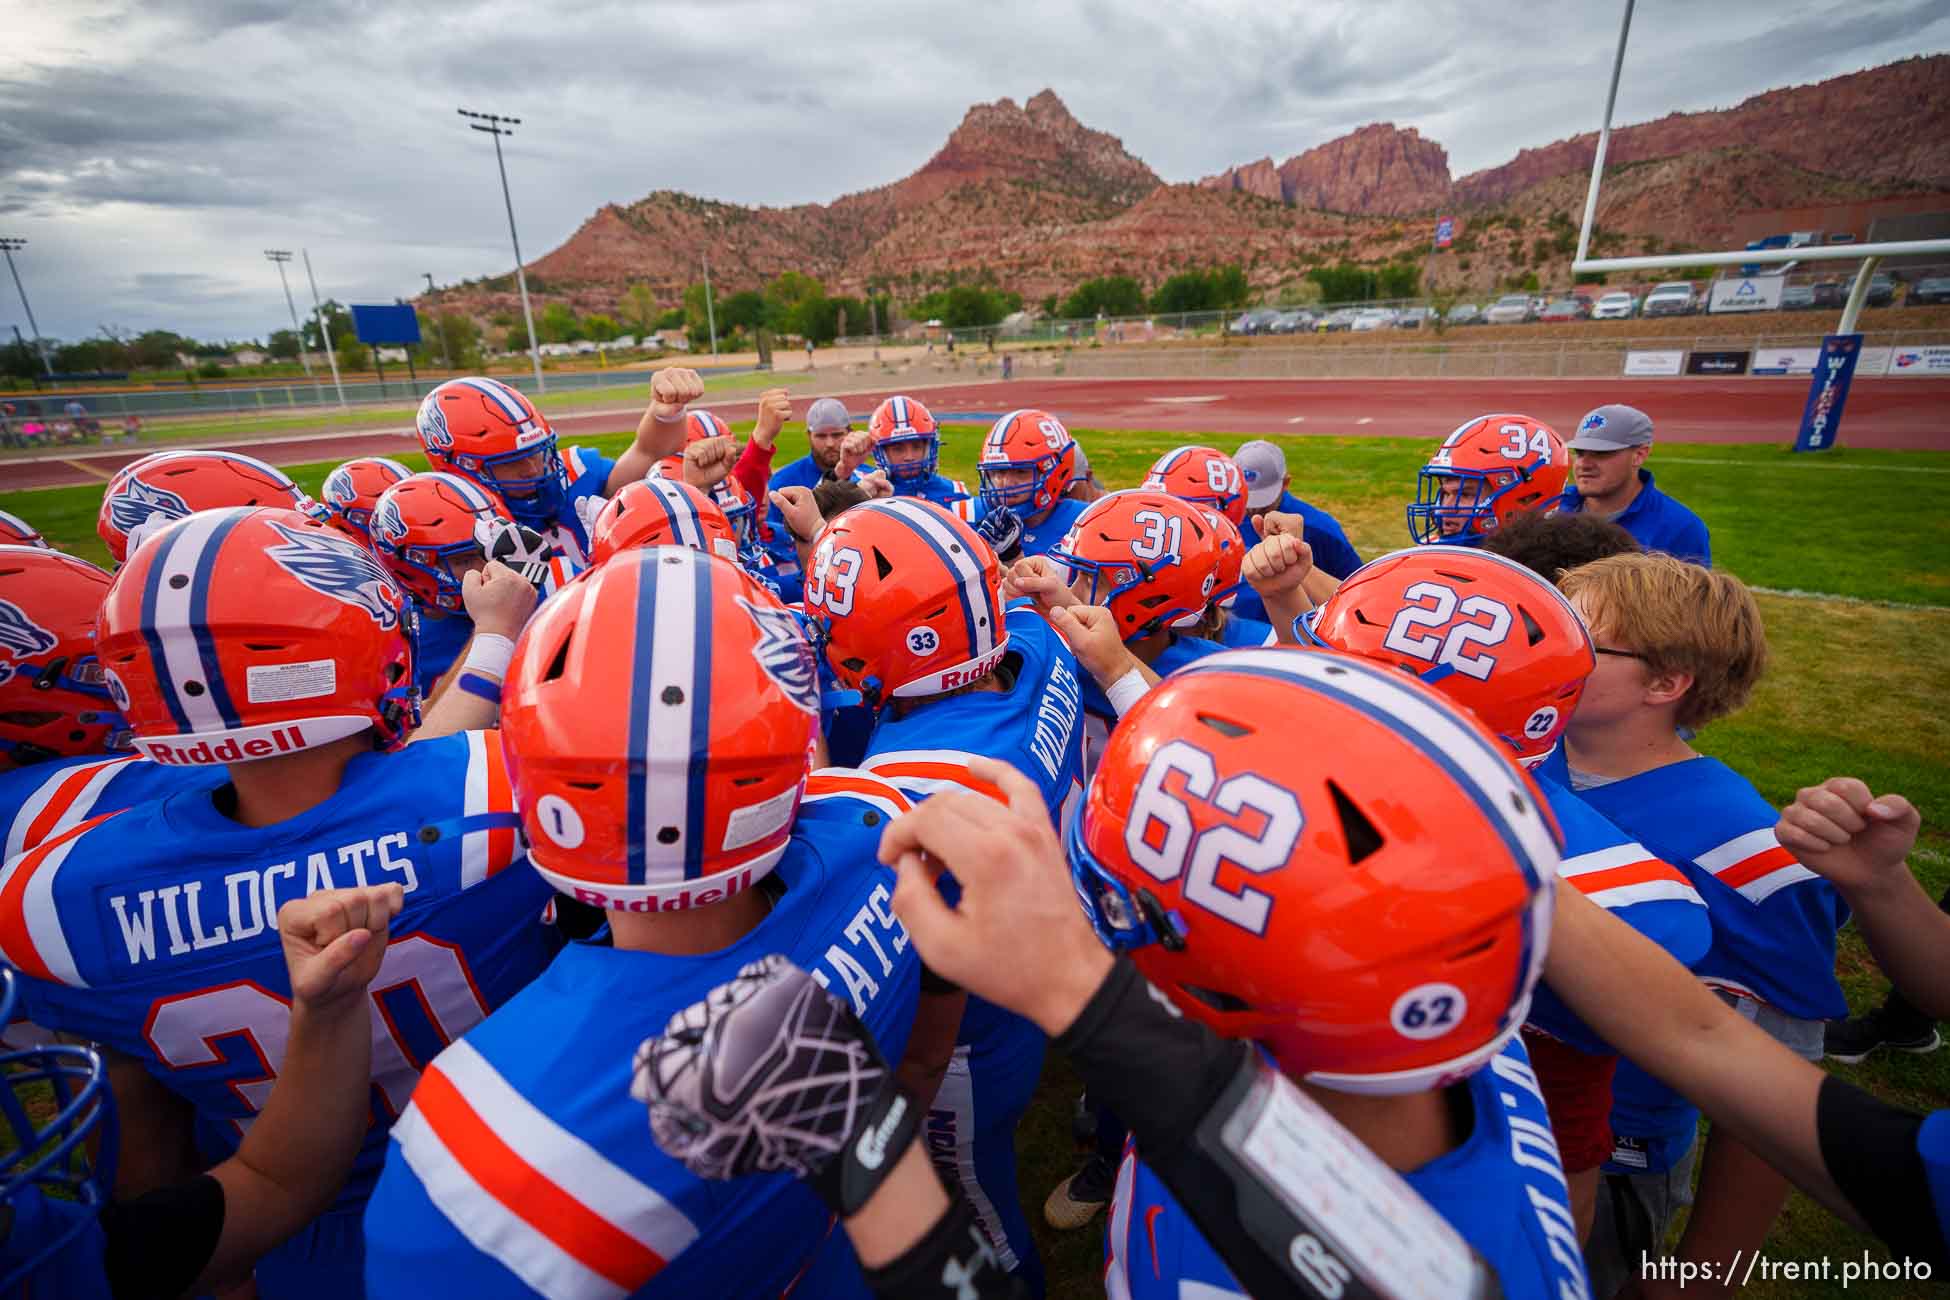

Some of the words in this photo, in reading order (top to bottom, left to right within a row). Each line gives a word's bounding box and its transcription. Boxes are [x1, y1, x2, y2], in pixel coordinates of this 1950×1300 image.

[1500, 424, 1552, 466] 34
[1205, 459, 1239, 495] 87
[1130, 510, 1182, 567] 31
[807, 540, 863, 617] 33
[910, 631, 936, 651] 33
[1383, 581, 1513, 682] 22
[1030, 655, 1079, 782] WILDCATS
[1526, 713, 1554, 732] 22
[147, 725, 307, 766] Riddell
[551, 807, 564, 836] 1
[1124, 738, 1306, 939] 62
[110, 832, 418, 965] WILDCATS
[573, 868, 753, 913] Riddell
[1402, 995, 1454, 1028] 62
[1617, 1135, 1640, 1149] XL
